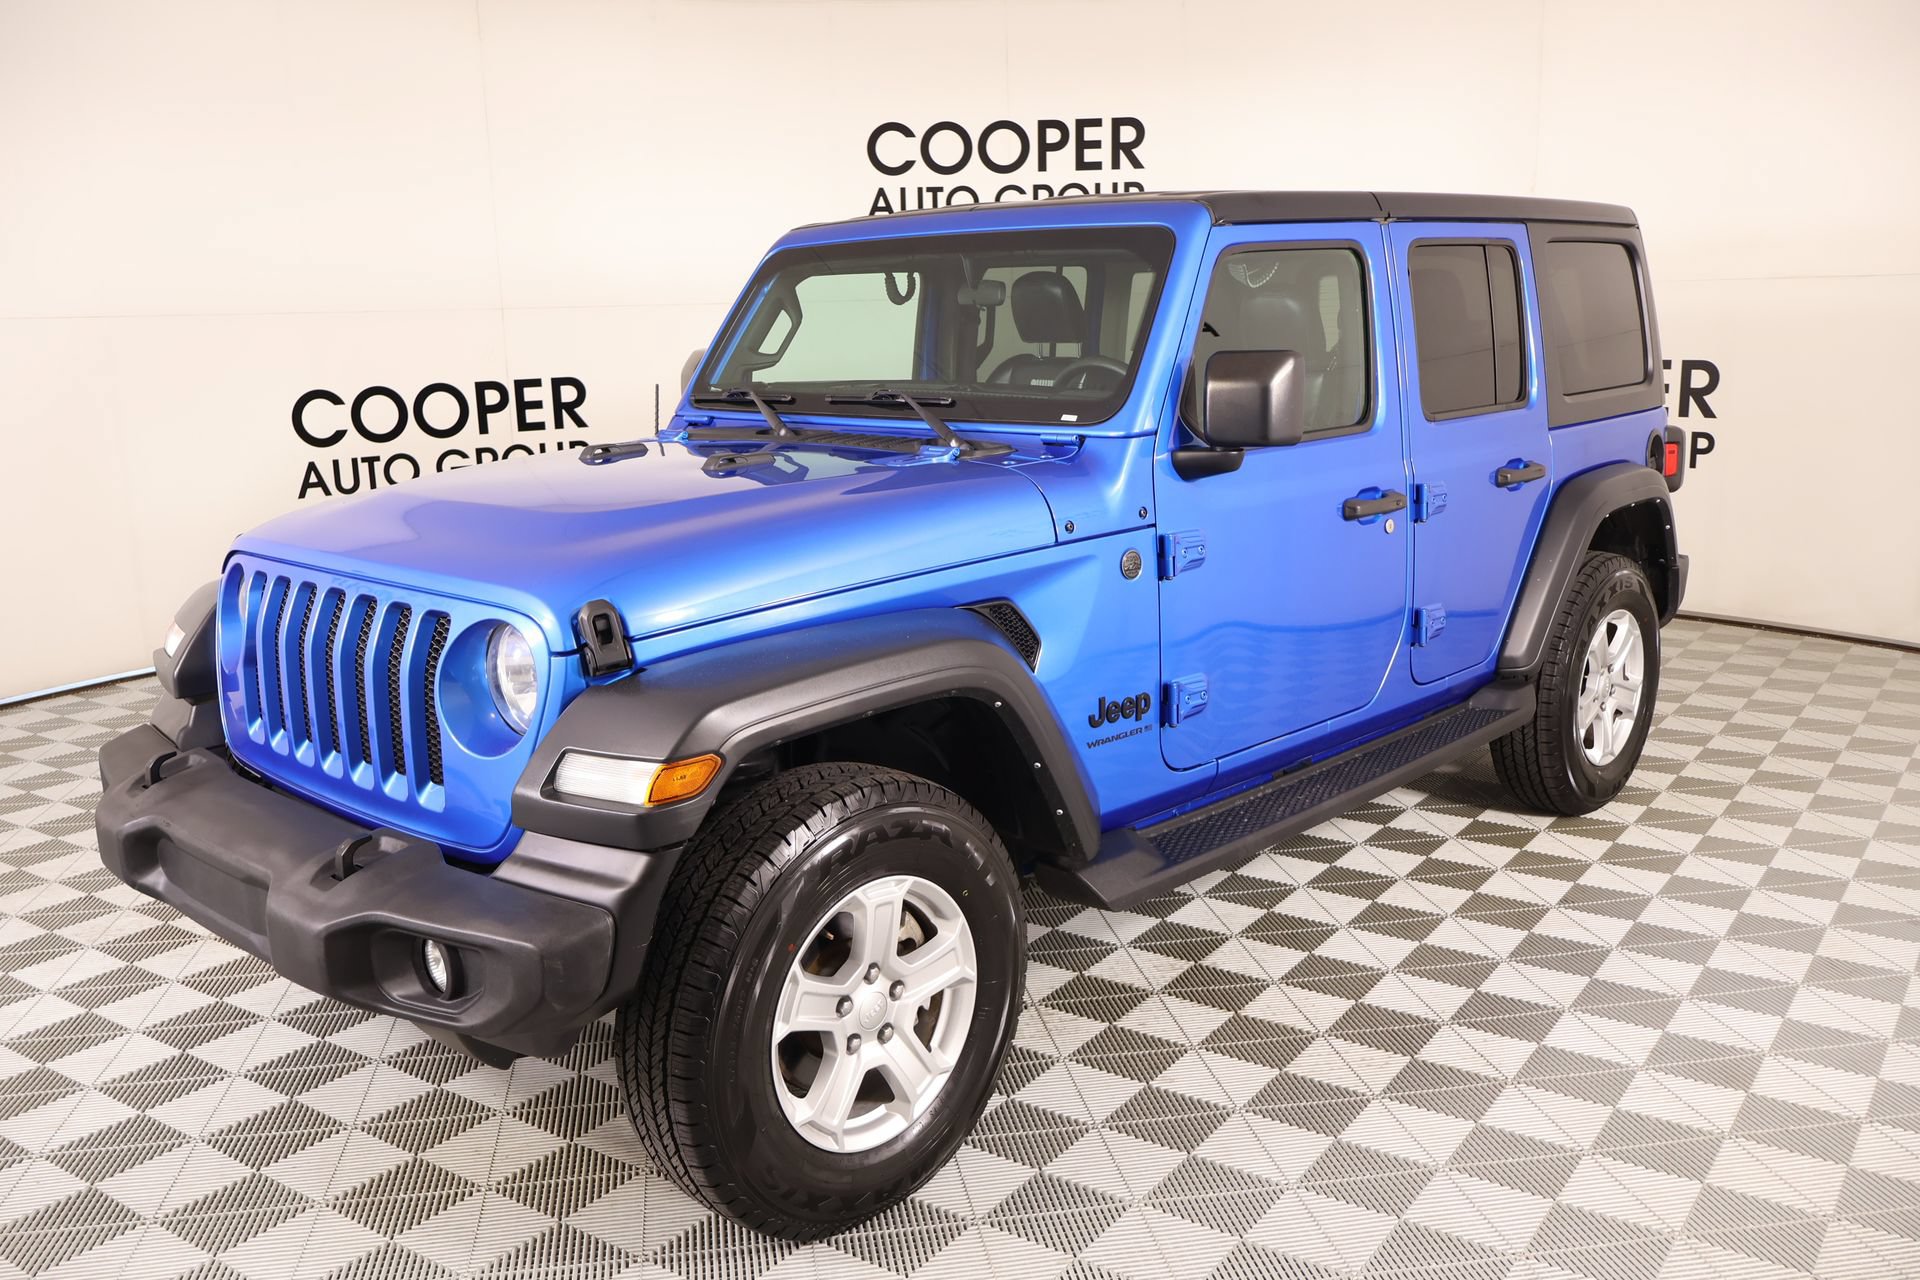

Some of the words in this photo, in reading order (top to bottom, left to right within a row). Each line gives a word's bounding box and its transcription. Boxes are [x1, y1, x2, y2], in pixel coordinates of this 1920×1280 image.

[867, 117, 1146, 176] COOPER
[291, 376, 589, 448] COOPER
[298, 453, 420, 499] AUTO
[1088, 692, 1151, 728] Jeep
[1085, 727, 1143, 749] WRANGLER
